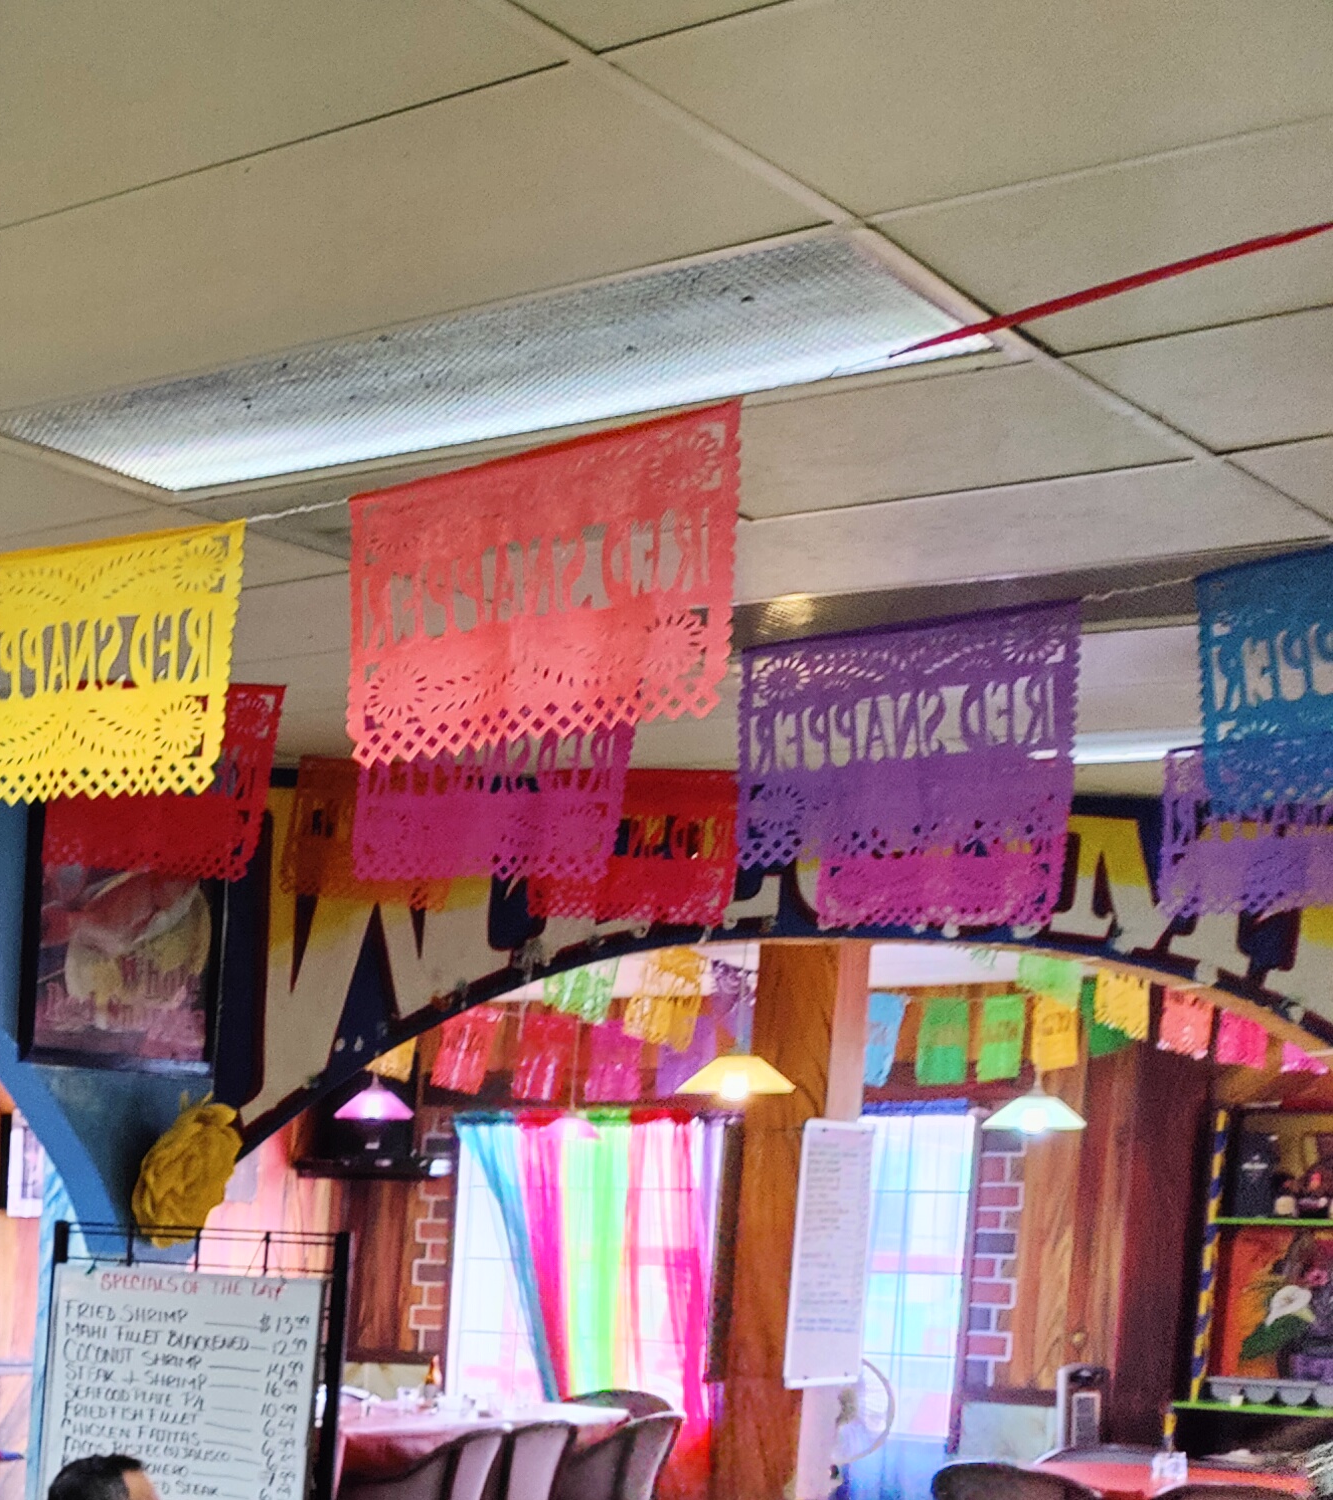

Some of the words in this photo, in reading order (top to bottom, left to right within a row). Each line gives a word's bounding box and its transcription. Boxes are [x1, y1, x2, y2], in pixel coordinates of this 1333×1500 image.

[100, 1273, 178, 1293] SPECIALS
[182, 1280, 200, 1295] OF
[213, 1281, 243, 1296] THE
[64, 1300, 115, 1322] FRIED
[121, 1304, 188, 1323] SHRIMP
[65, 1322, 108, 1340] MAHI
[114, 1325, 163, 1344] FILLET
[63, 1338, 134, 1364] COCONUT
[141, 1350, 202, 1370] SHRIMP
[64, 1362, 115, 1383] STEAK
[144, 1370, 207, 1391] SHRIMP
[64, 1383, 131, 1402] SEAFOOD
[64, 1400, 108, 1420] FRIED
[109, 1404, 143, 1421] FISH
[148, 1407, 198, 1426] FILLET
[61, 1417, 131, 1439] CHICKEN
[176, 1480, 219, 1498] STEAK
